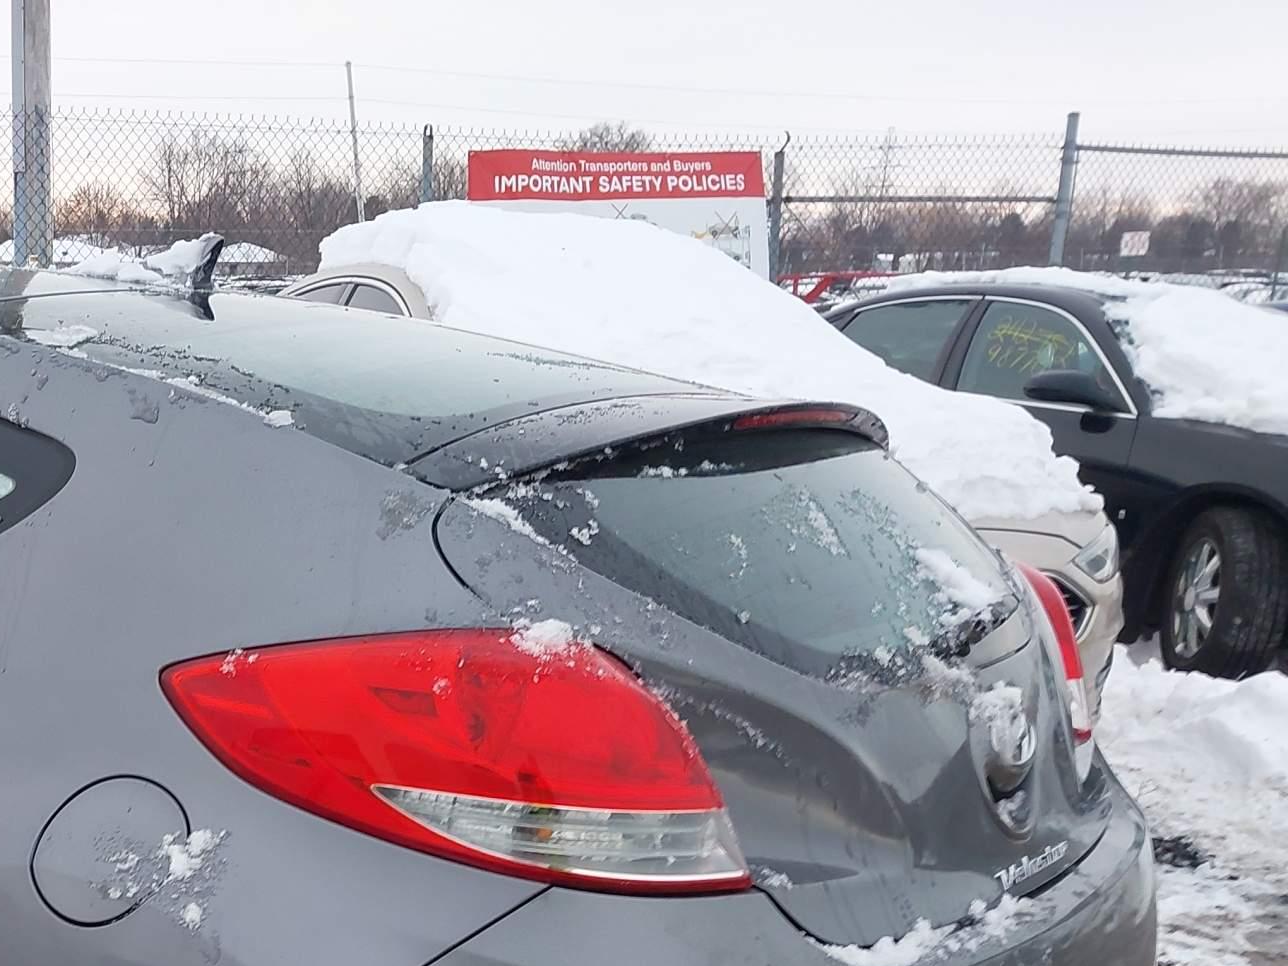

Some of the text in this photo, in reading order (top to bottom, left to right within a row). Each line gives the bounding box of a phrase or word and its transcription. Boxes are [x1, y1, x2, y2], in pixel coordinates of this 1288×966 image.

[531, 158, 712, 174] Attention Transporters and Buyers
[494, 173, 746, 193] IMPORTANT SAFETY POLICIES
